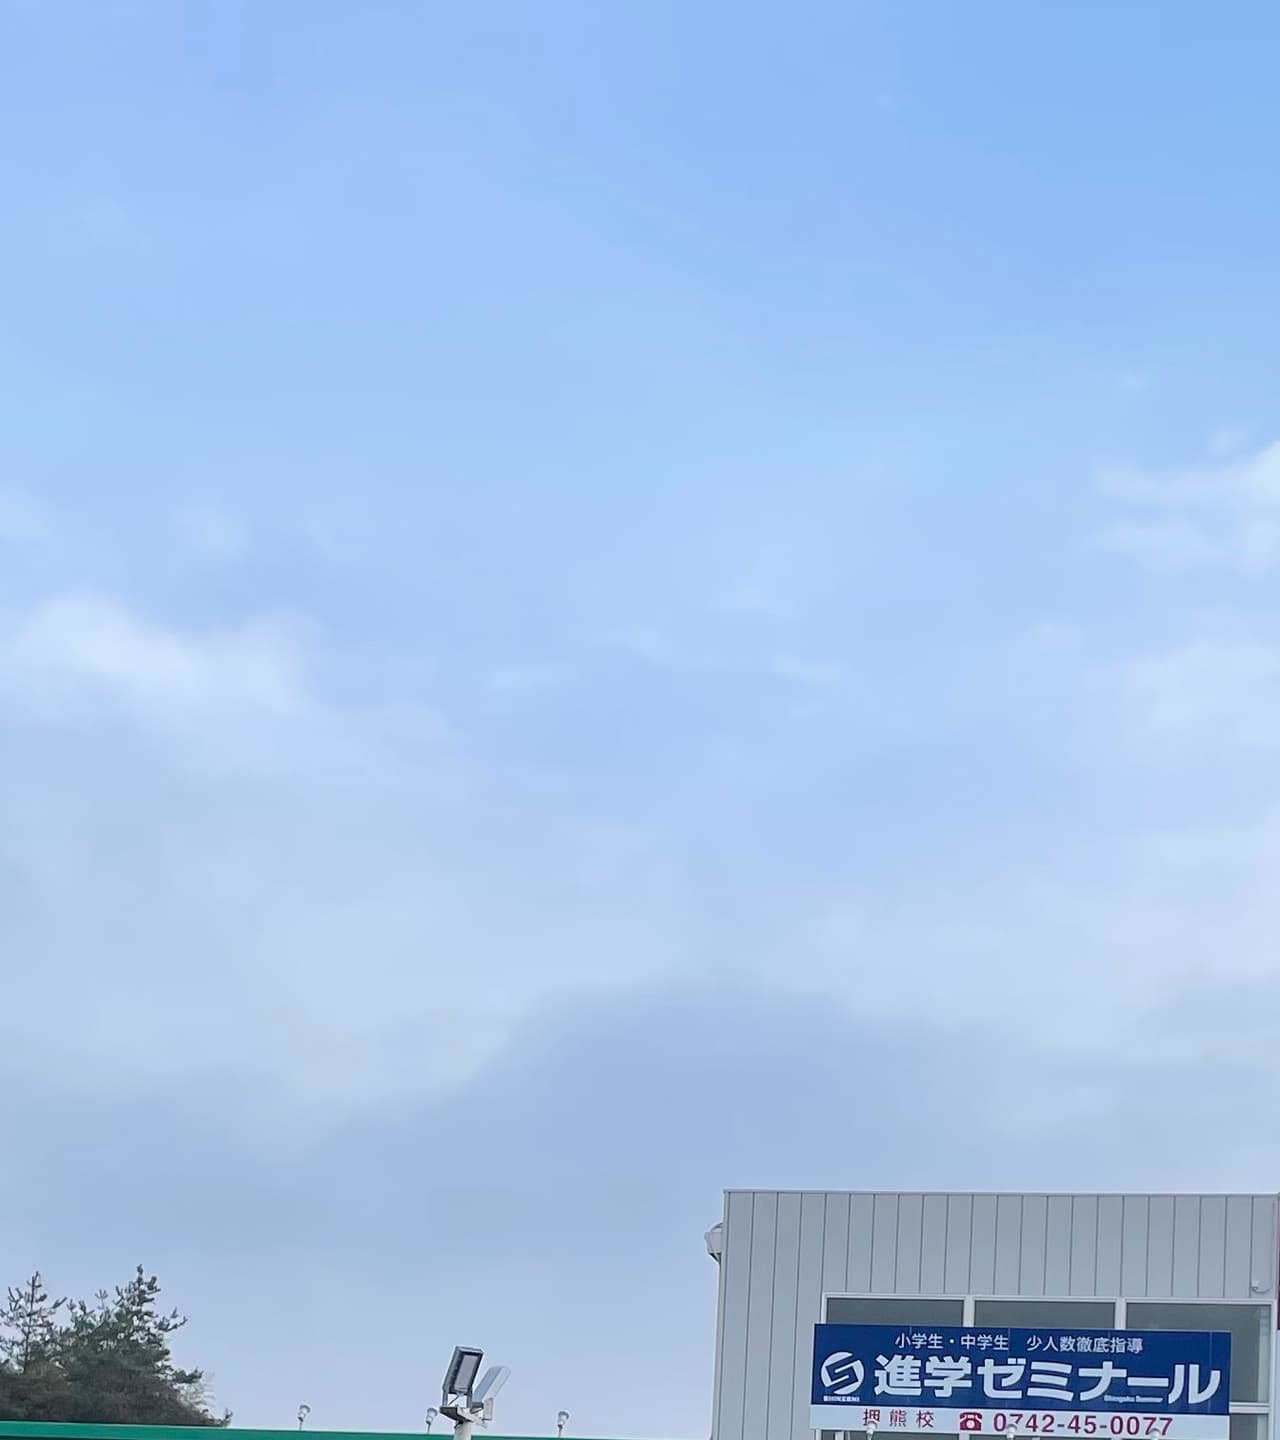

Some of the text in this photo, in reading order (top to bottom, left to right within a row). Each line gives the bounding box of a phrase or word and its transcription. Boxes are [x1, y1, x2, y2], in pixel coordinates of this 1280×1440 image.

[894, 1332, 1144, 1355] 小学生・中学生 少人数徹底指導
[873, 1354, 1221, 1405] 進学ゼミナール
